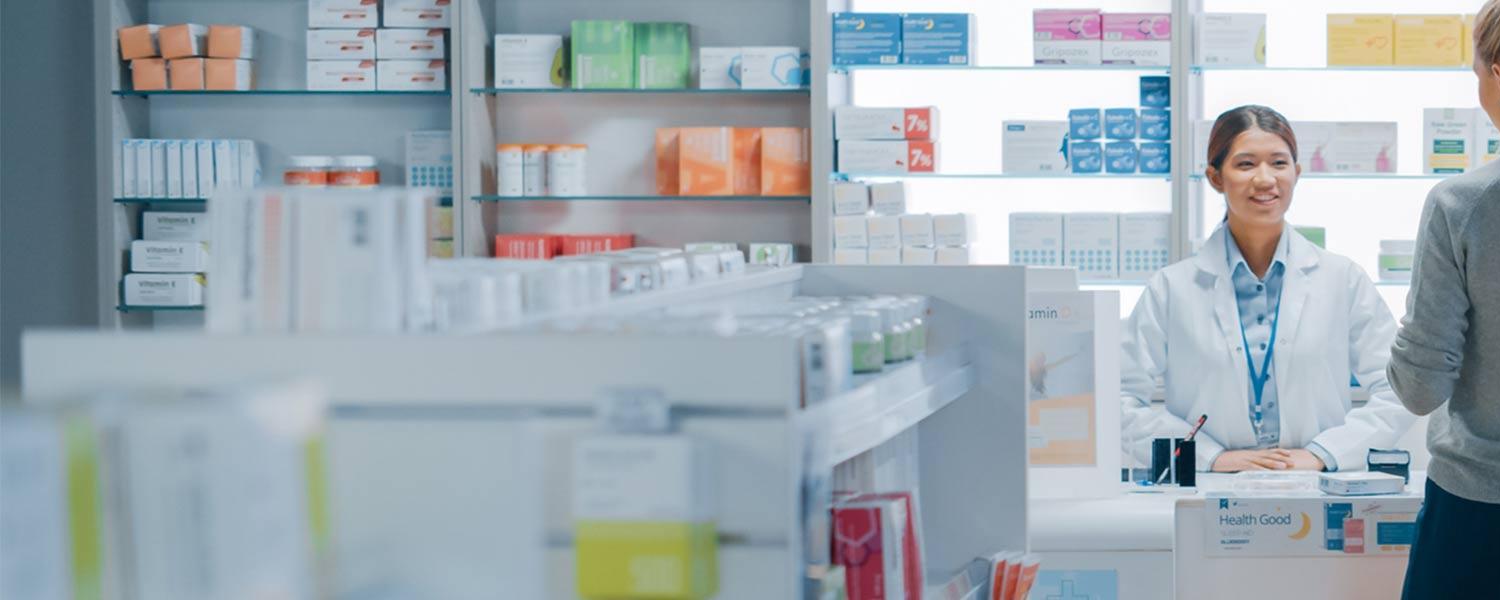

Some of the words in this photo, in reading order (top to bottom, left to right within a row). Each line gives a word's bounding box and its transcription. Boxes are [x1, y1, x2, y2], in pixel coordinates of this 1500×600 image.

[907, 114, 928, 132] 7%
[911, 148, 933, 167] 7%
[157, 216, 188, 224] Vitamin
[1219, 513, 1257, 526] Health
[1260, 513, 1292, 526] Good
